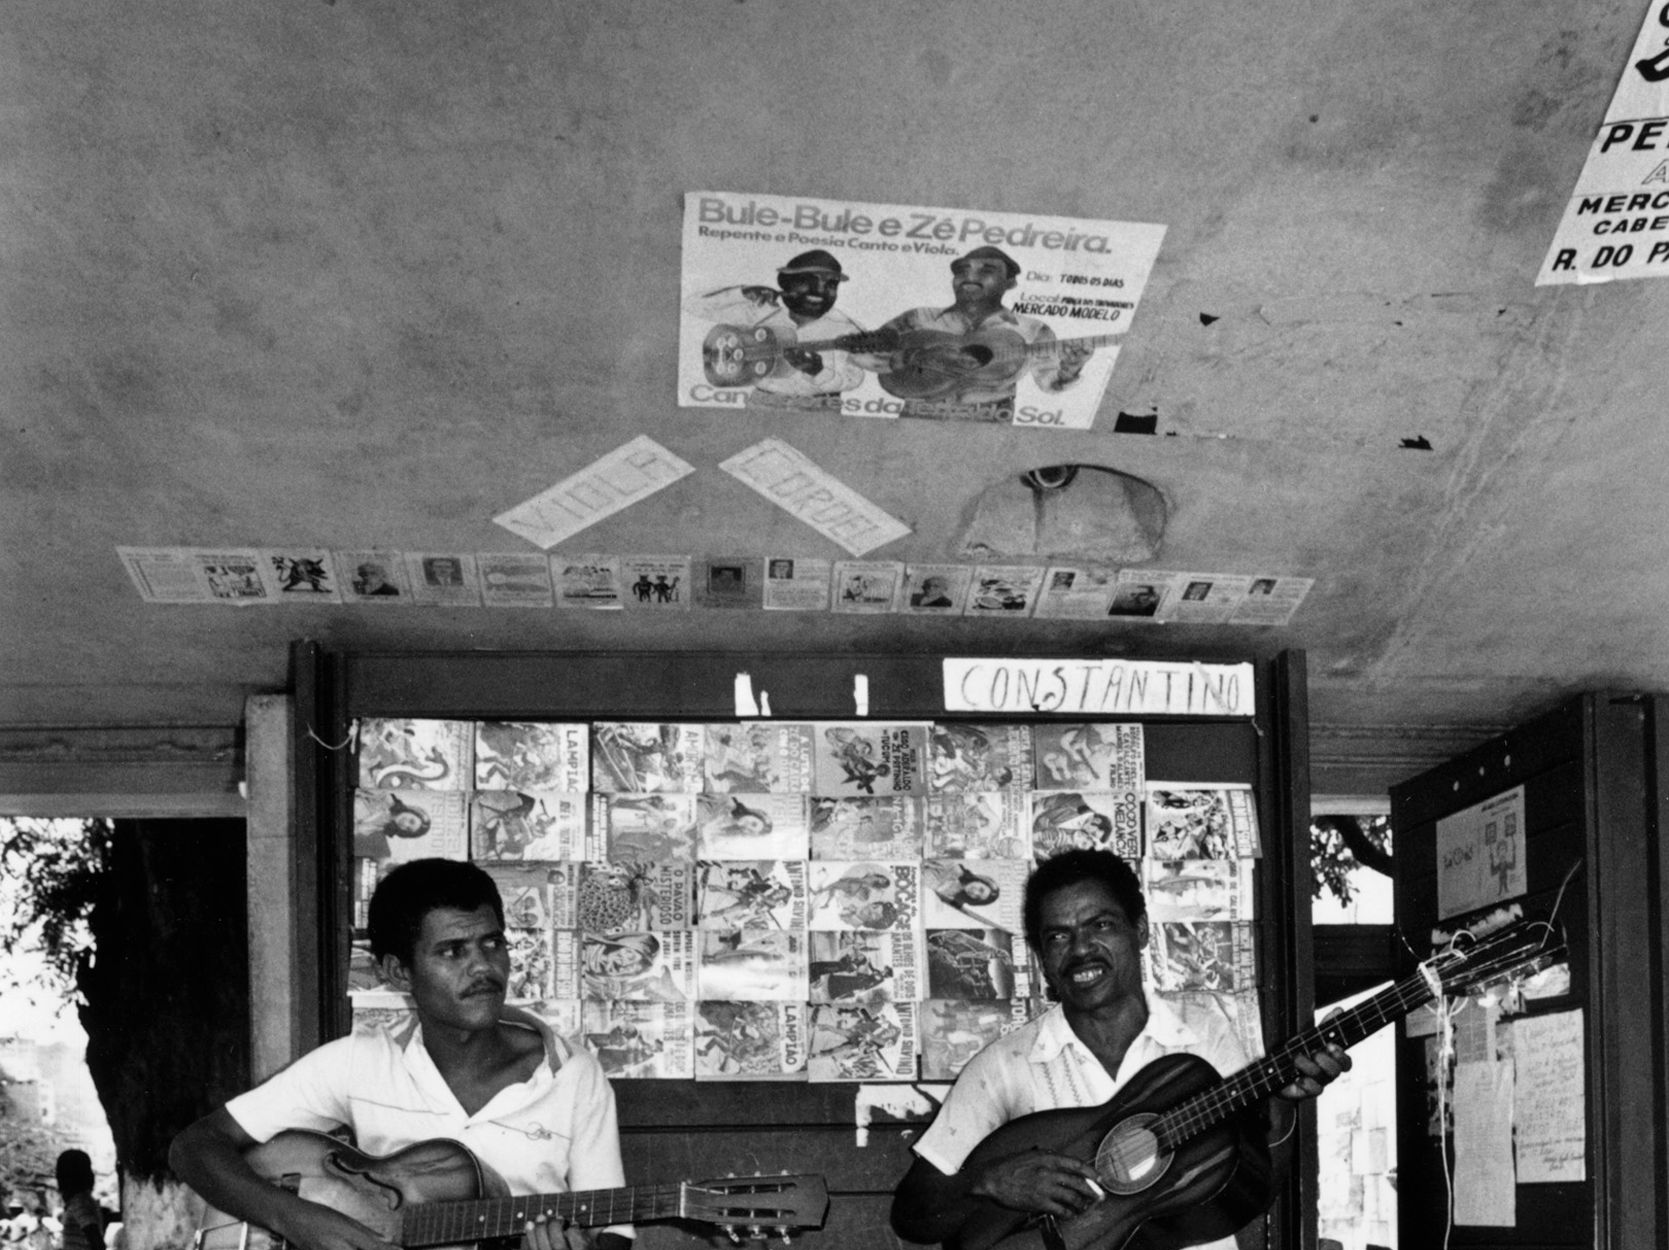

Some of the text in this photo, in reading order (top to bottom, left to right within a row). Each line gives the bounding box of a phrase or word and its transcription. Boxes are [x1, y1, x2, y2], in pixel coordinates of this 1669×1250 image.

[1600, 122, 1669, 153] PE
[699, 198, 1113, 254] Bule-Bule e Zé Pedreira.
[699, 226, 772, 242] Repente
[775, 234, 786, 243] e
[788, 232, 846, 248] Poesia
[847, 238, 899, 252] Canto
[901, 244, 912, 254] e
[1552, 248, 1577, 271] R.
[1591, 244, 1633, 268] DO
[1010, 302, 1120, 321] MERCADO MODELO
[1016, 405, 1065, 426] Sol.
[961, 664, 1239, 713] CONSTANTINO
[895, 866, 911, 930] BOCAGE
